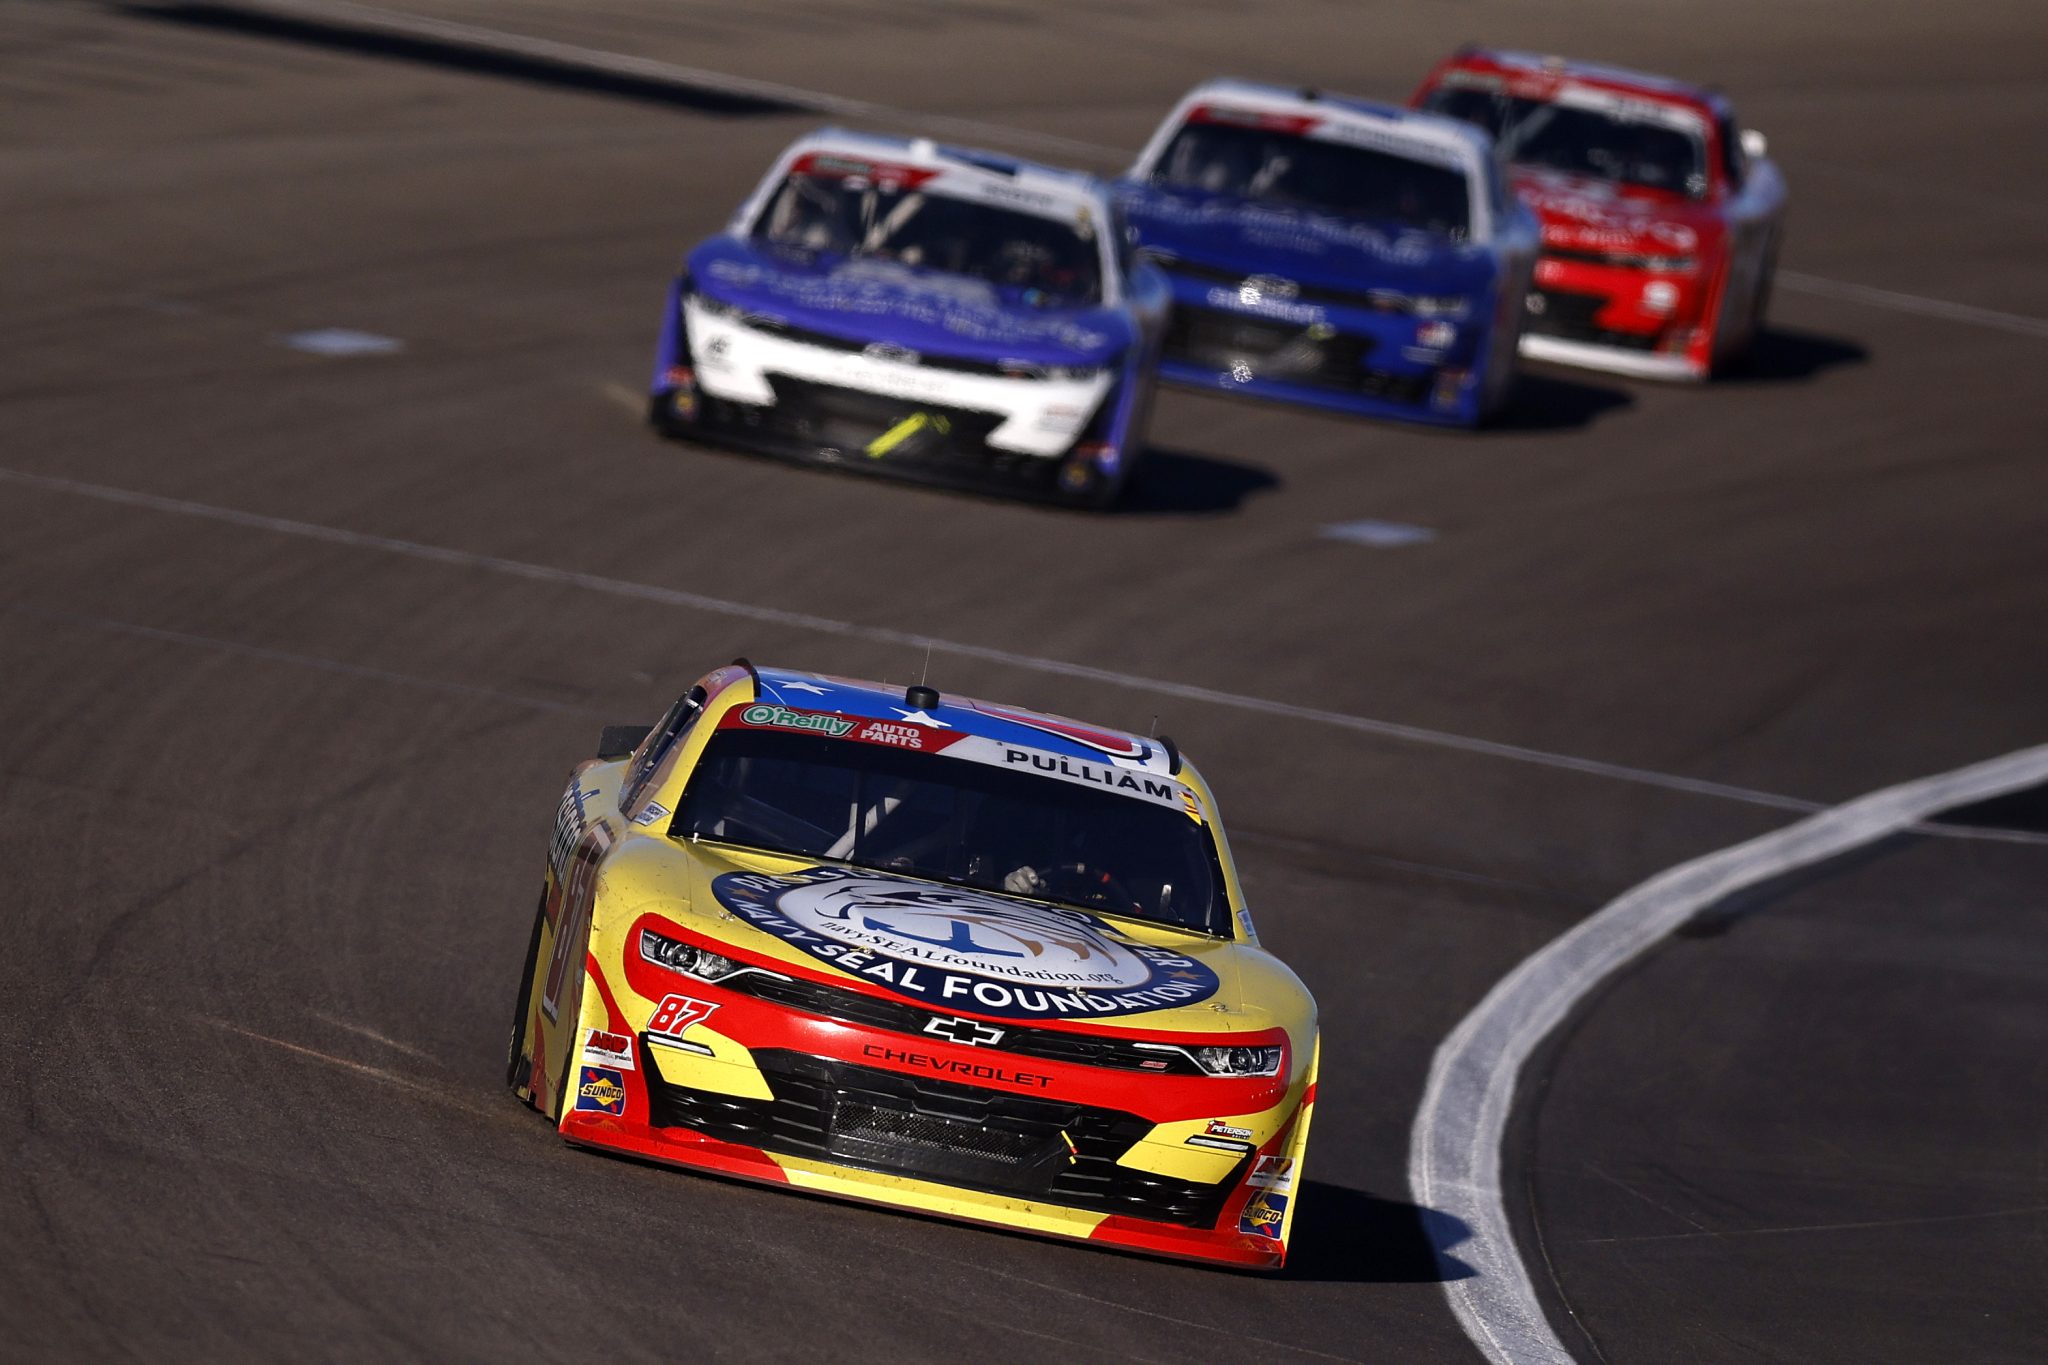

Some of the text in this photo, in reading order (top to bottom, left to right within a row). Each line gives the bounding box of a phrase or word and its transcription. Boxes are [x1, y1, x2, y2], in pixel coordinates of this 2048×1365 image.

[742, 705, 857, 736] O'Reilly
[868, 722, 920, 738] AUTO
[860, 730, 923, 748] PARTS
[1005, 749, 1173, 801] PULLIAM
[729, 897, 1206, 1013] NAVY SEAL FOUNDATION
[820, 921, 1124, 985] navySEALfoundation.org
[647, 993, 722, 1038] 87
[586, 1030, 629, 1054] ARP
[863, 1044, 1055, 1088] CHEVROLET
[582, 1084, 624, 1099] SUNOCO
[1211, 1124, 1253, 1136] PETERSON
